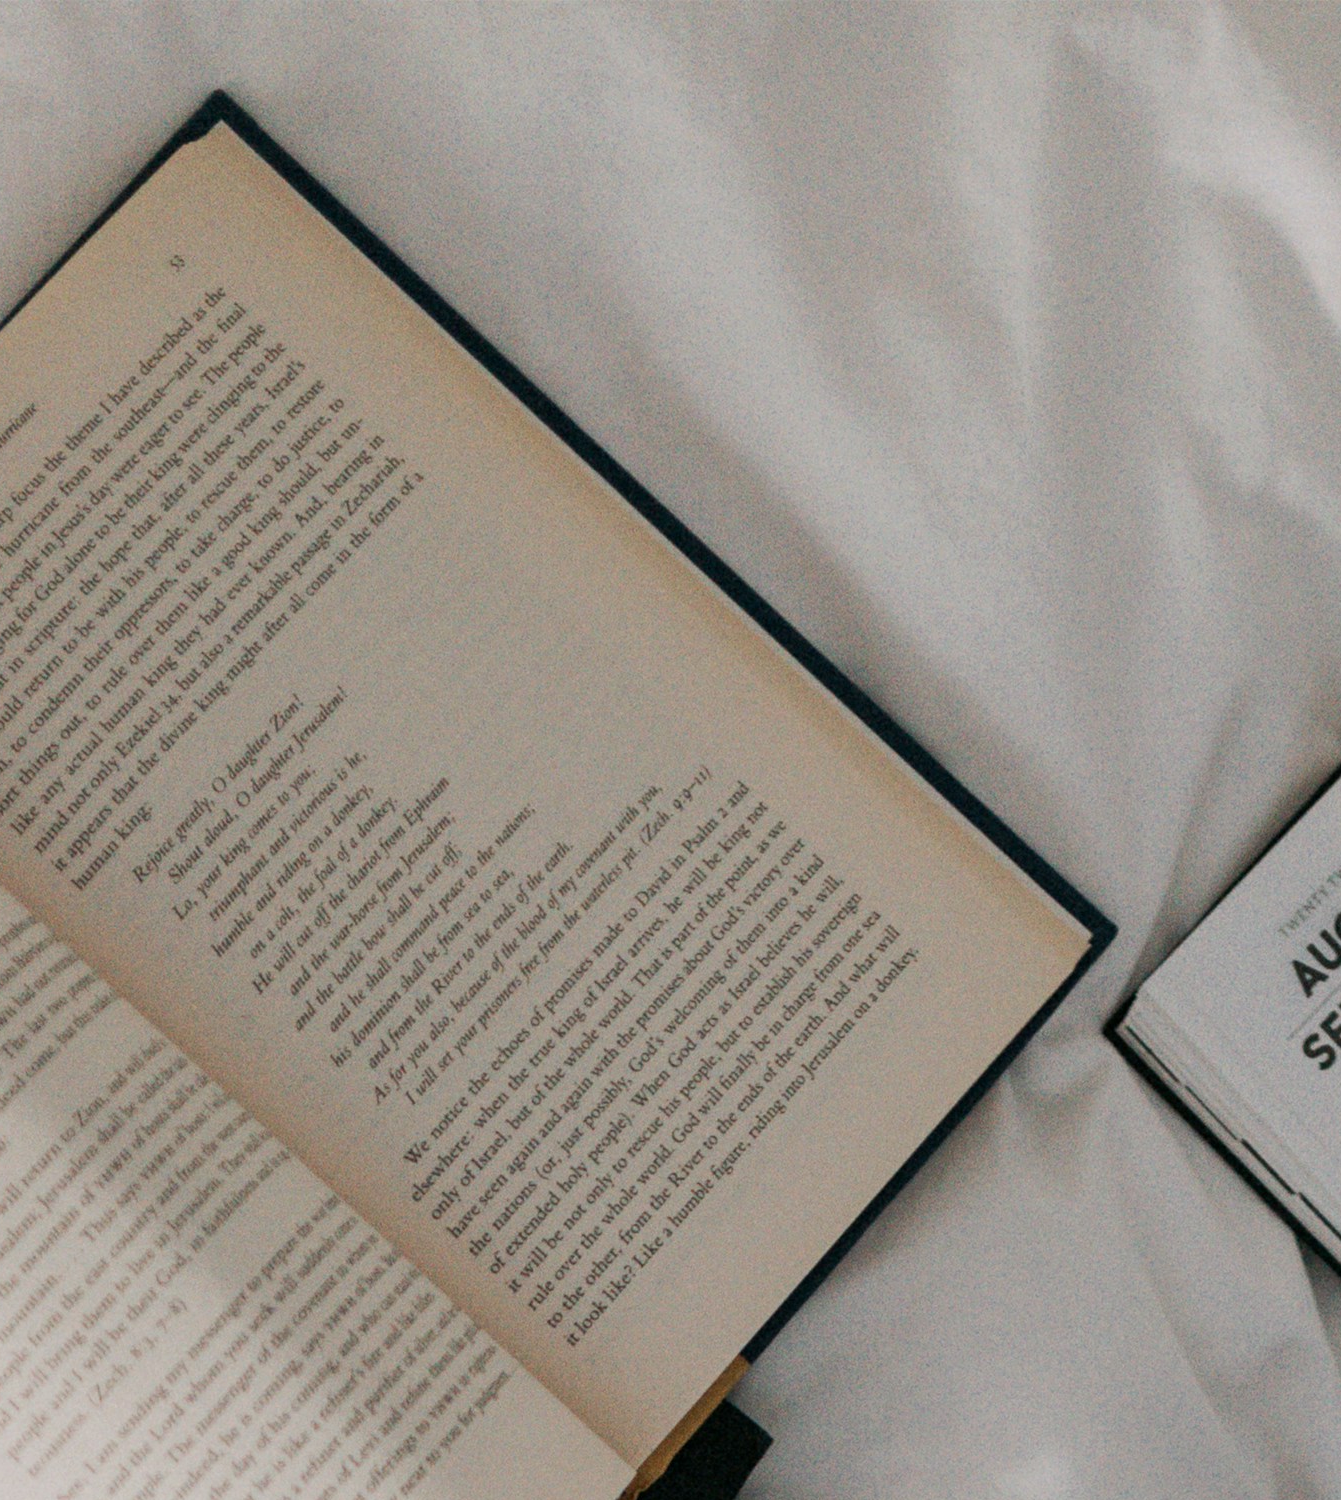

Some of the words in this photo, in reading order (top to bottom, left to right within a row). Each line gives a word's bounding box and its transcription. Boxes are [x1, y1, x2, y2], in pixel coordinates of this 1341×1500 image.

[9, 472, 47, 508] focus
[42, 450, 68, 473] the
[64, 413, 104, 452] theme
[106, 375, 141, 407] have
[138, 316, 195, 377] described
[191, 306, 208, 323] as
[204, 286, 227, 309] the
[1278, 885, 1330, 937] TWENTY
